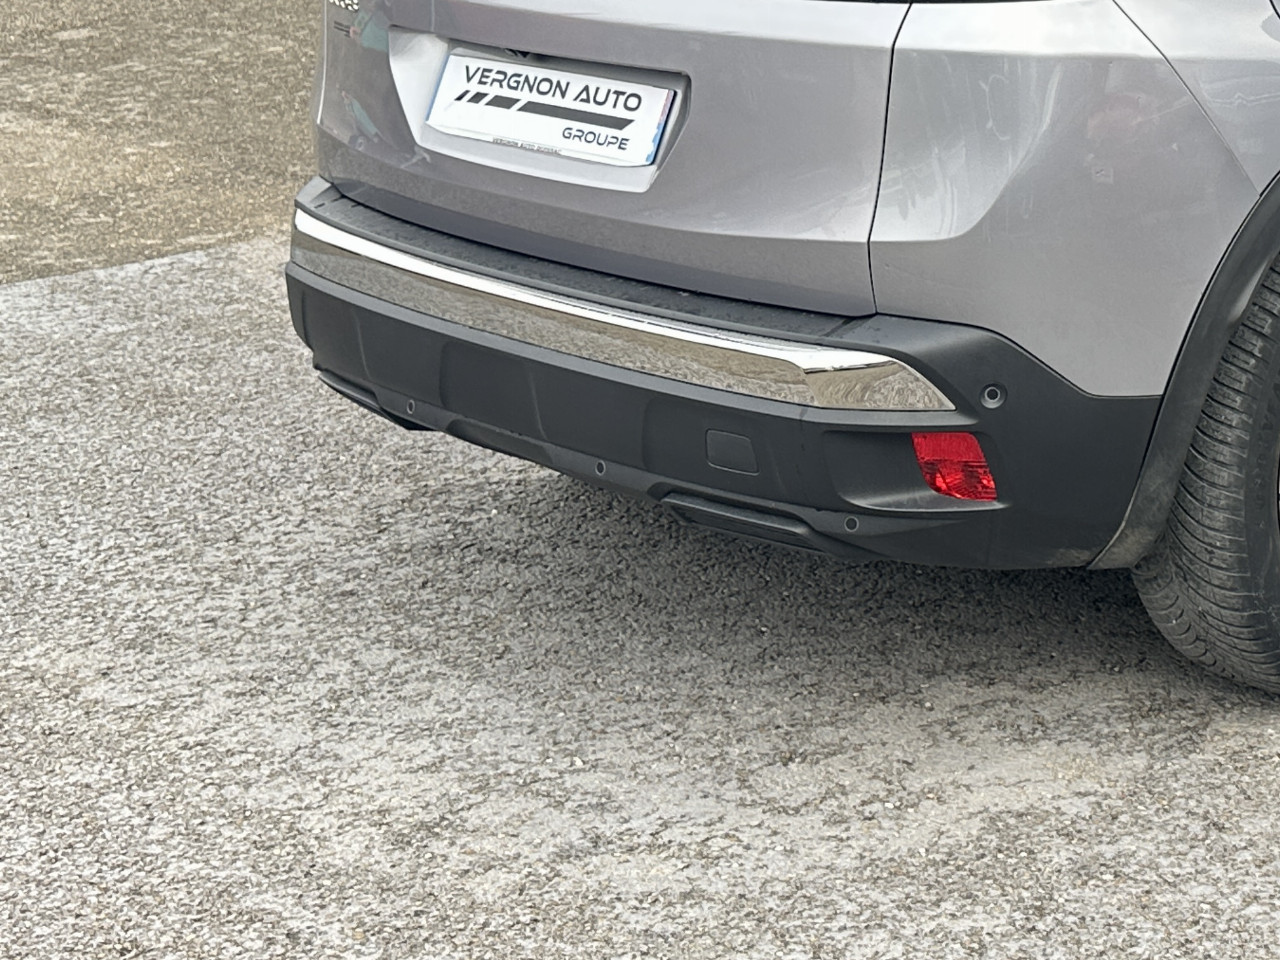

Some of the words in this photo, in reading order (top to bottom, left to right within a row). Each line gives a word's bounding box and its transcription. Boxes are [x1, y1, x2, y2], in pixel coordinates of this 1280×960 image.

[465, 65, 570, 99] VERGNON
[573, 84, 642, 112] AUTO
[562, 127, 630, 151] GROUPE
